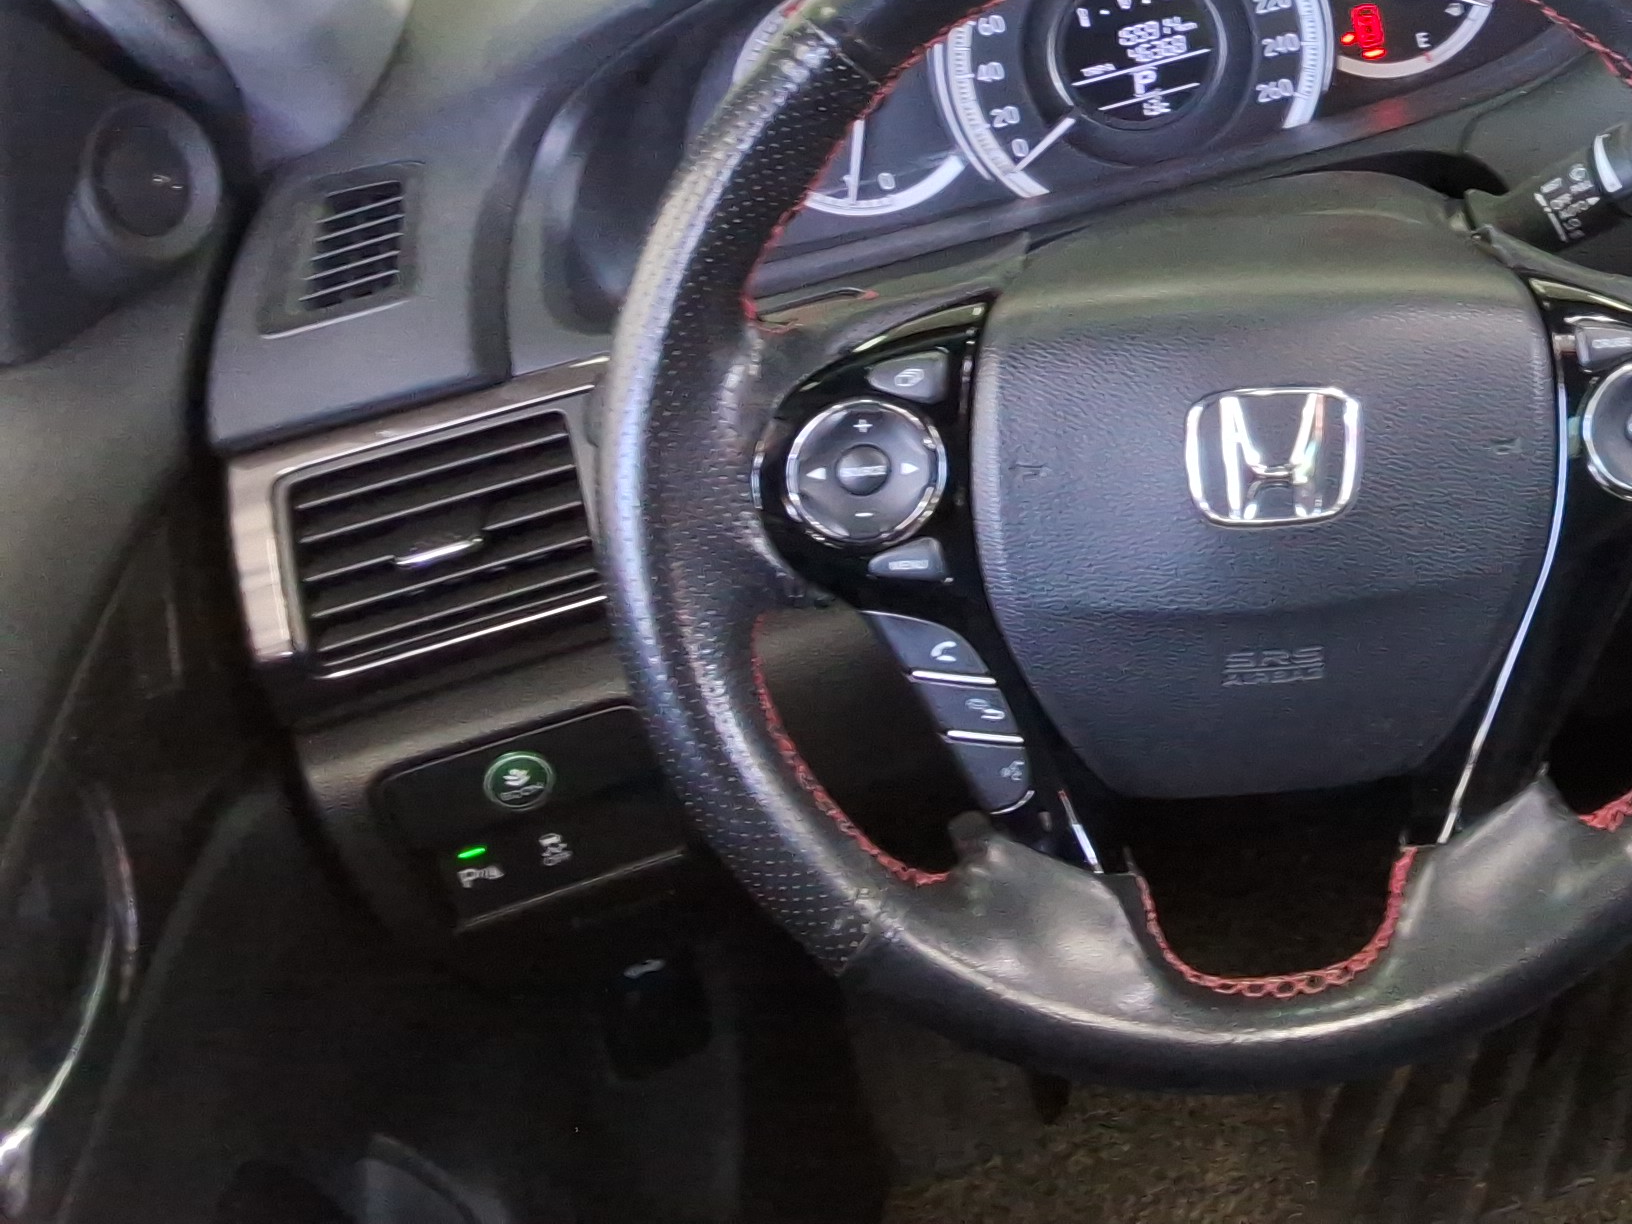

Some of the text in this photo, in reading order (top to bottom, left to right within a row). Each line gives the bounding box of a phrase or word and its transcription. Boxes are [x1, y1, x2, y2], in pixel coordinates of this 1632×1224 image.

[978, 14, 1006, 36] 60
[1262, 33, 1301, 57] 240
[1416, 31, 1431, 49] E
[977, 61, 1005, 82] 40
[1130, 66, 1158, 98] P
[1256, 78, 1295, 104] 260
[990, 106, 1021, 128] 20
[1011, 138, 1029, 158] 0
[877, 172, 896, 190] 0
[1225, 646, 1324, 669] SRS
